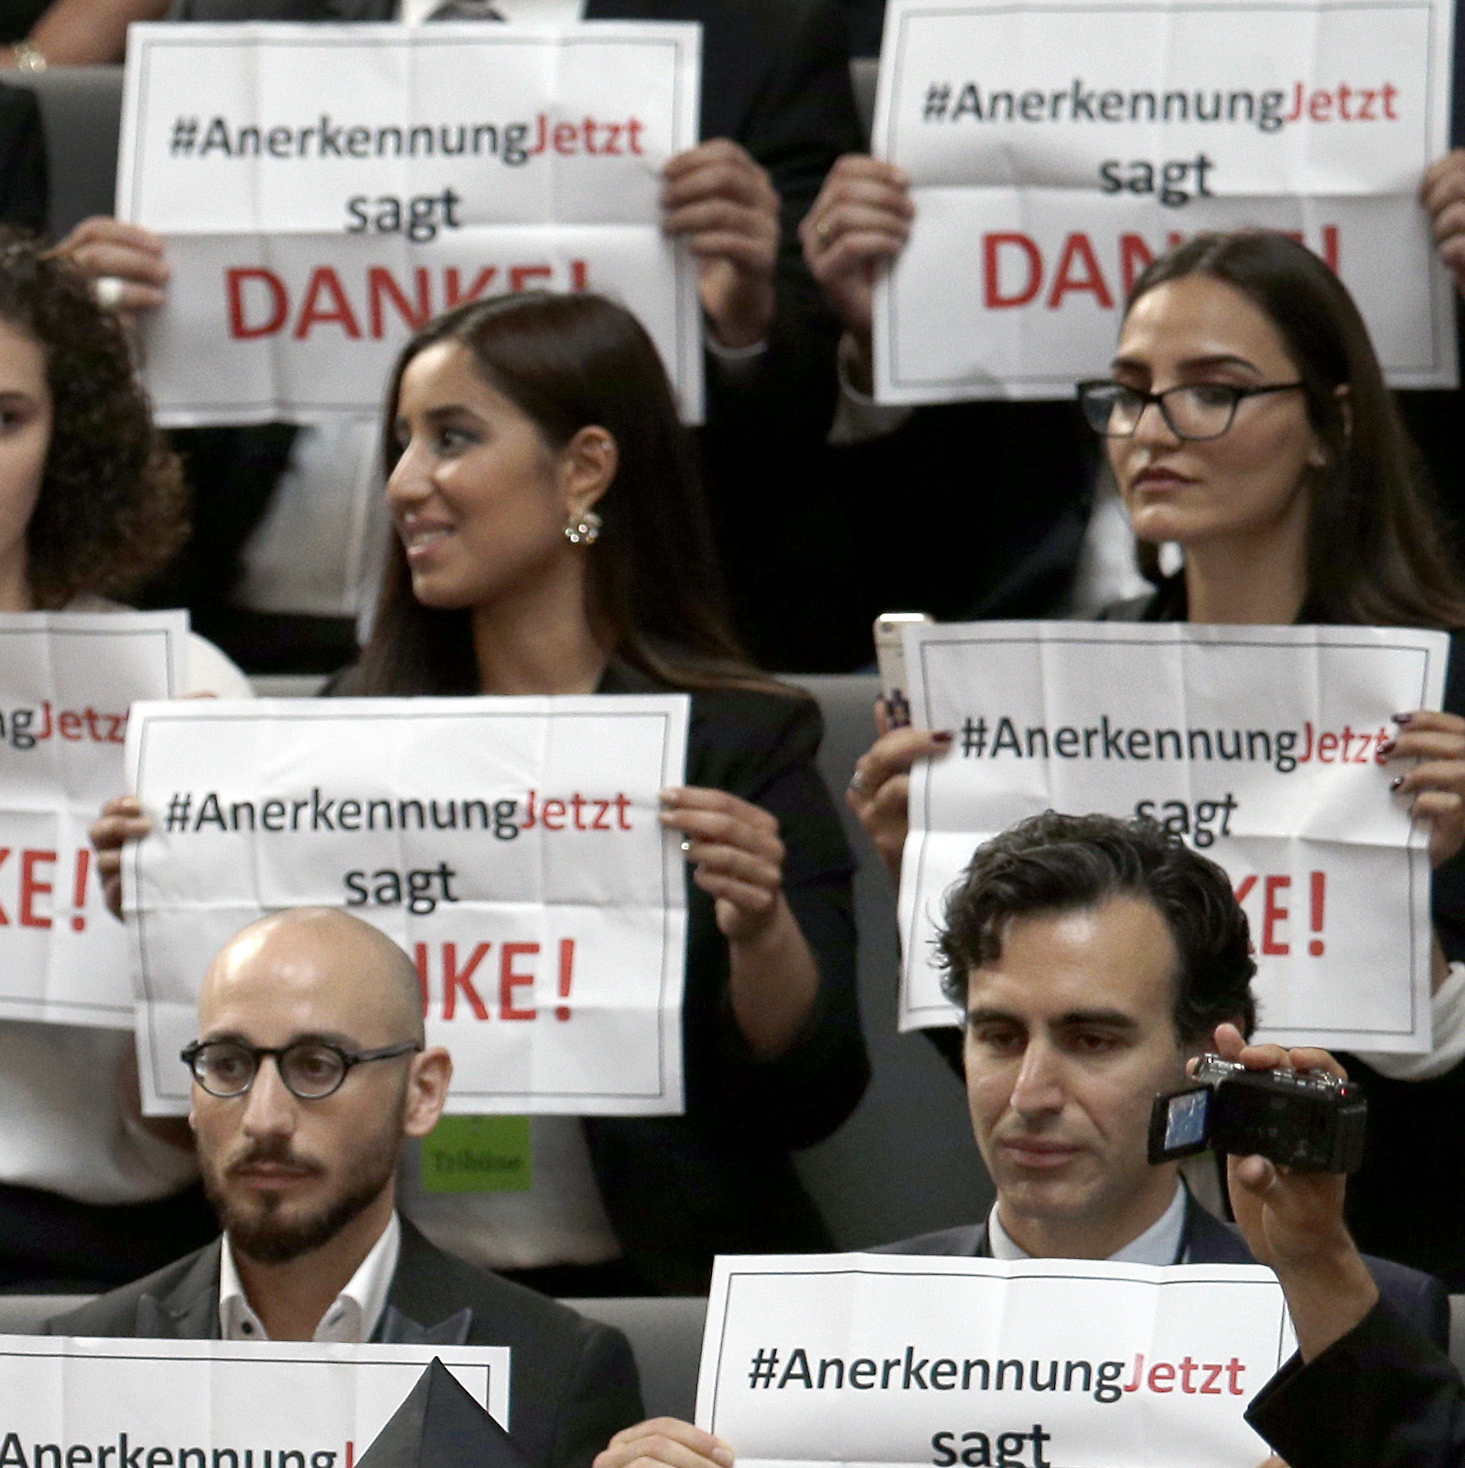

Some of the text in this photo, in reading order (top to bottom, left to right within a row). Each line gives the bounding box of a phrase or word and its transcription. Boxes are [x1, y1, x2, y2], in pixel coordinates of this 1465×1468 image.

[923, 79, 1397, 134] #AnerkennungJetzt
[170, 113, 645, 167] #AnerkennungJetzt
[1098, 152, 1216, 204] sagt
[345, 187, 460, 246] sagt
[962, 715, 1389, 772] #AnerkennungJetzt
[163, 786, 631, 842] #AnerkennungJetzt
[344, 861, 458, 916] sagt
[748, 1346, 1246, 1404] #AnerkennungJetzt
